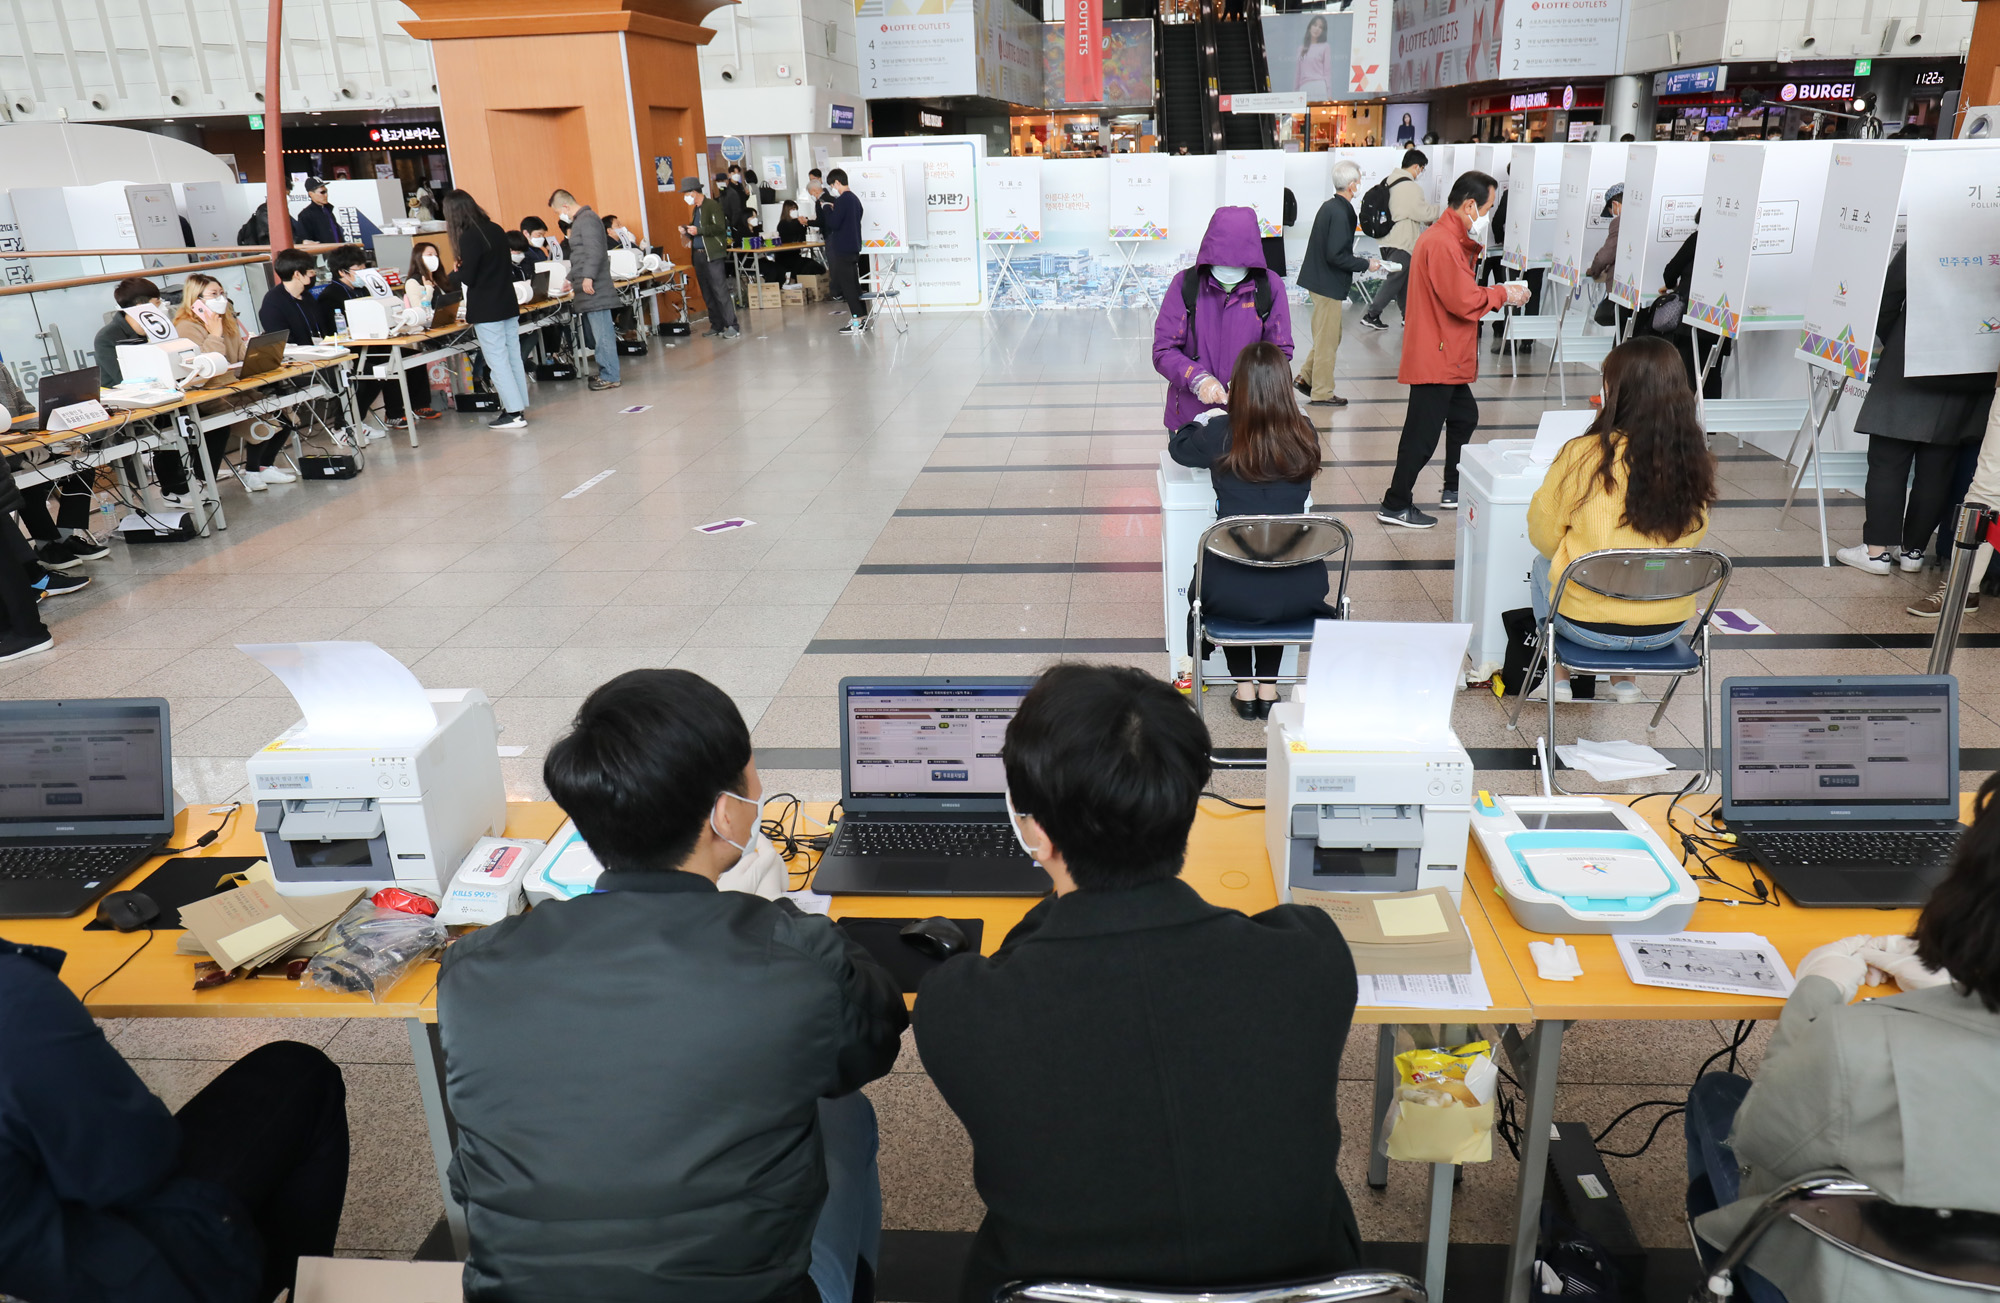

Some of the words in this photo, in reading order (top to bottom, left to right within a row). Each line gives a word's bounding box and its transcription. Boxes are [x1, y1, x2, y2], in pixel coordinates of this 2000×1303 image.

[889, 23, 917, 32] LOTTE
[918, 22, 951, 30] OUTLETS
[1079, 0, 1088, 55] OUTLETS
[1366, 0, 1378, 44] UTLETS
[1515, 18, 1523, 29] 4
[1404, 30, 1427, 52] LOTTE
[1428, 20, 1459, 46] OUTLETS
[868, 40, 875, 50] 4
[1514, 38, 1521, 50] 3
[870, 59, 876, 69] 3
[1512, 59, 1519, 70] 2
[871, 78, 878, 88] 2
[1916, 71, 1938, 85] 11:22
[1799, 83, 1855, 99] BURGE
[1533, 91, 1547, 106] KING
[380, 127, 441, 143] 불고기브라더스
[927, 193, 963, 206] 선거란?
[1045, 193, 1068, 201] 아름다운
[1071, 192, 1084, 200] 선거
[1716, 196, 1740, 209] 기표소
[1045, 202, 1063, 211] 행복한
[1065, 201, 1090, 211] 대한민국
[1839, 206, 1871, 224] 기표소
[1939, 256, 1983, 267] 민주주의
[473, 890, 498, 898] 99.9%
